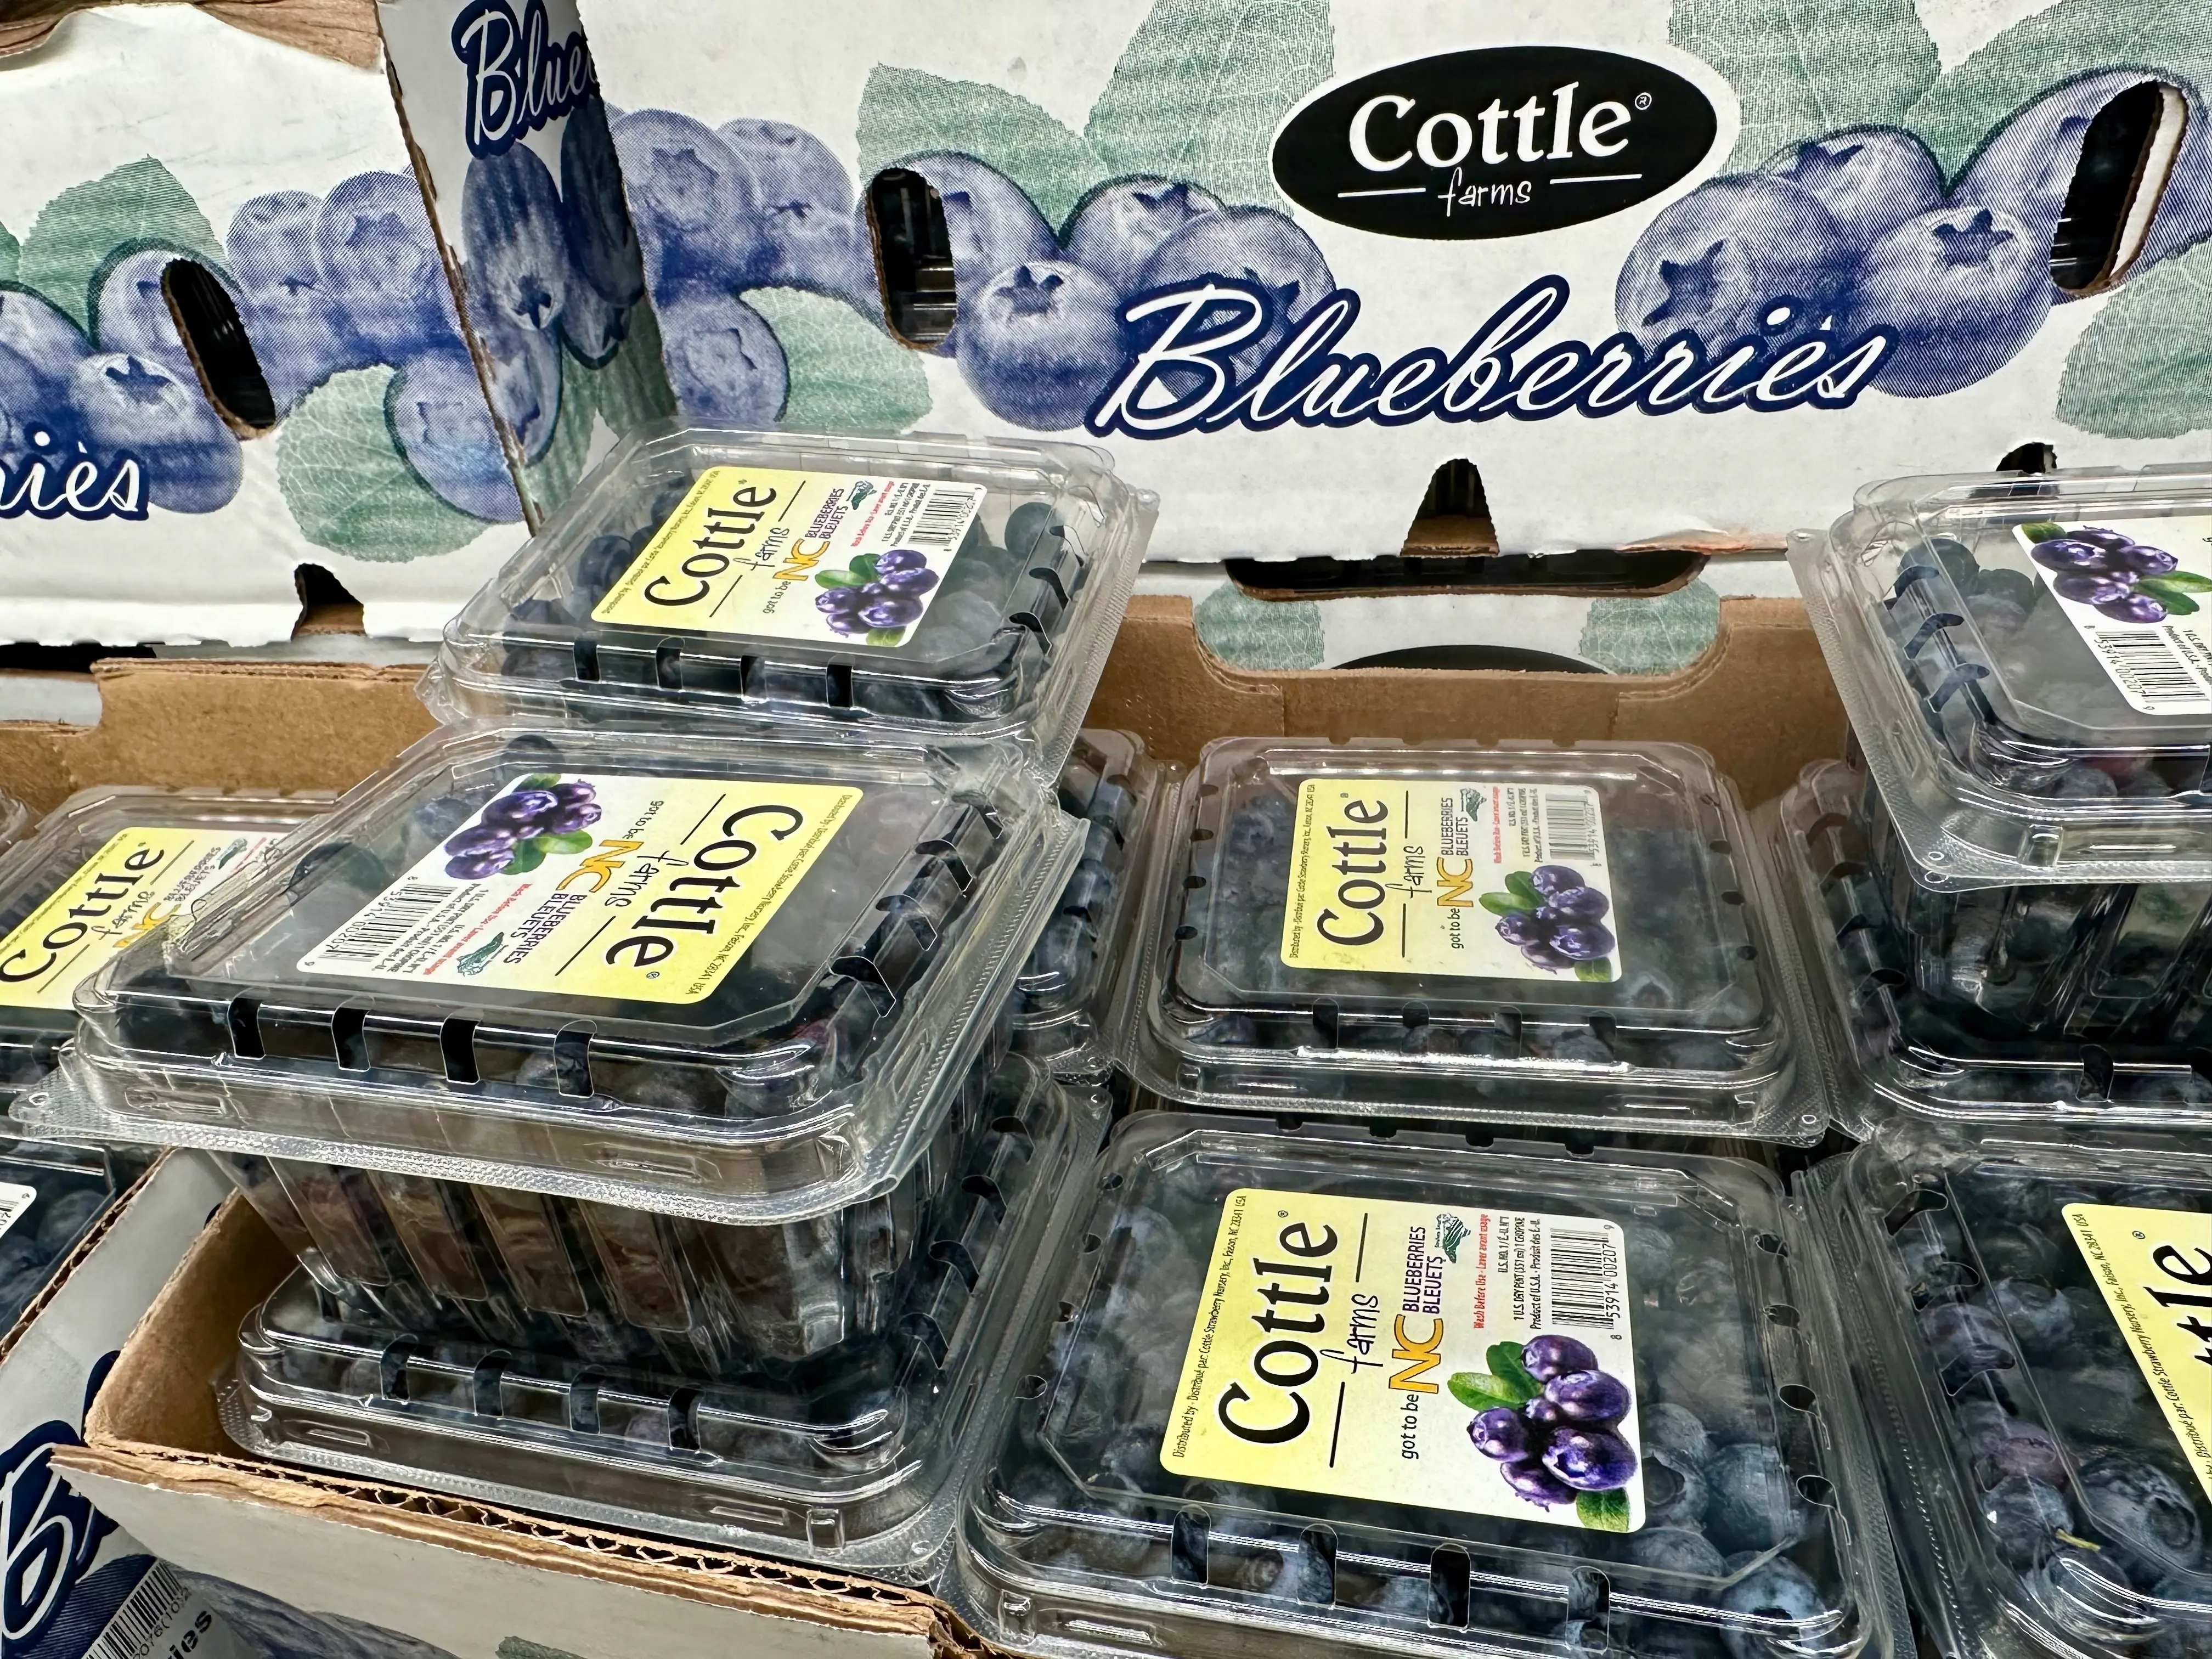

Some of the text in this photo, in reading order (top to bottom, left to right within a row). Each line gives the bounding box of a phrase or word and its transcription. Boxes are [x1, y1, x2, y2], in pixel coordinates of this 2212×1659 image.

[1437, 166, 1532, 217] farms
[733, 527, 790, 571] farms
[772, 538, 831, 582] NC
[775, 580, 791, 590] be
[622, 828, 644, 839] be
[635, 817, 652, 826] to
[1441, 797, 1454, 855] BLUEBERRIES
[1455, 816, 1469, 856] BLEUETS
[555, 839, 645, 893] NC
[604, 850, 689, 909] farms
[1385, 845, 1432, 899] farms
[1436, 857, 1474, 907] NC
[0, 848, 165, 983] Cottle
[326, 921, 366, 950] 00207
[503, 894, 588, 963] BLUEBERRIES
[510, 893, 569, 940] BLEUETS
[1447, 907, 1464, 949] got to be
[2072, 1214, 2089, 1227] USA
[1402, 1226, 1426, 1312] BLUEBERRIES
[1601, 1243, 1617, 1277] 00207
[2092, 1246, 2107, 1261] NC
[1422, 1255, 1445, 1314] BLEUETS
[1604, 1283, 1621, 1318] 53914
[1320, 1294, 1383, 1374] farms
[1530, 1302, 1541, 1329] Product
[1388, 1313, 1444, 1395] NC
[2137, 1334, 2168, 1378] Strawberry
[1400, 1394, 1419, 1459] got to be
